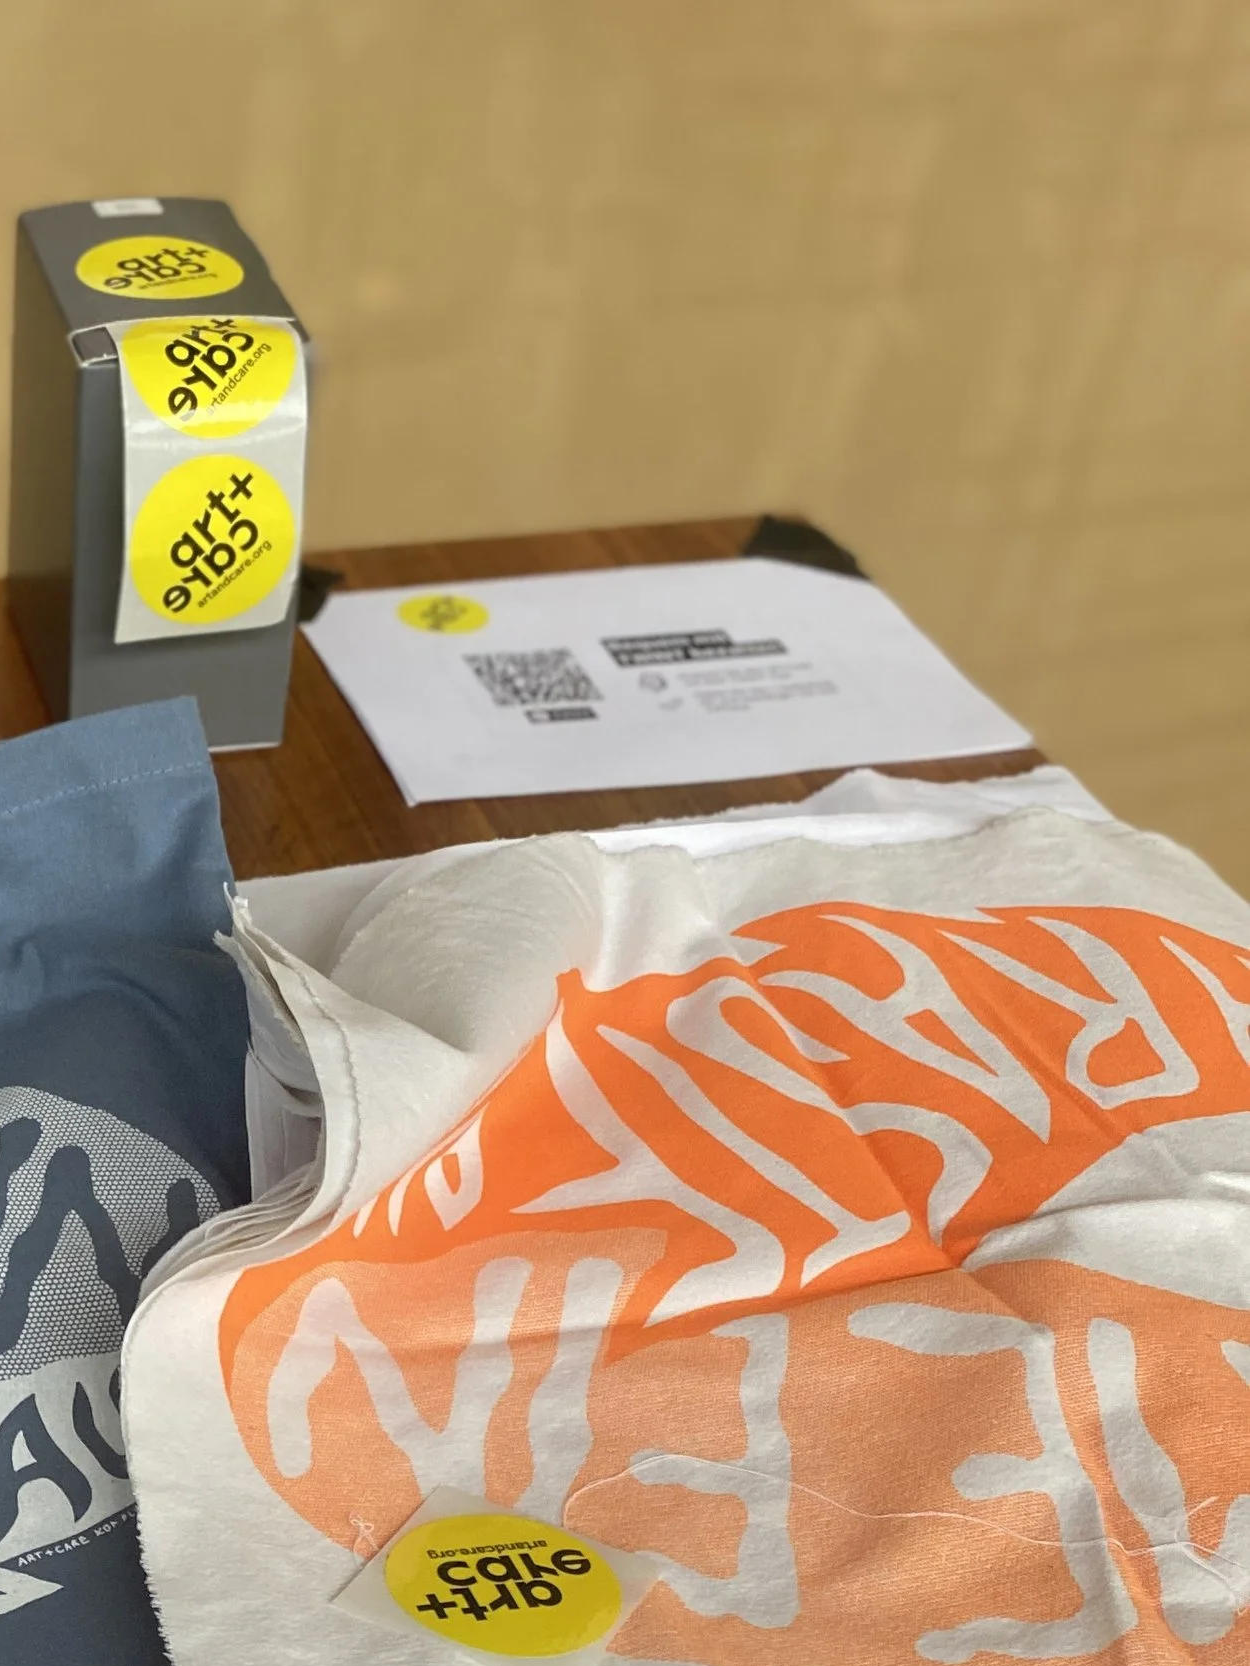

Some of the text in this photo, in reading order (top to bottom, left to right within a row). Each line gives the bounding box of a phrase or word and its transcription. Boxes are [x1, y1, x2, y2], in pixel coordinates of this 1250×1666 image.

[168, 332, 254, 421] care
[170, 472, 254, 568] art+
[163, 519, 258, 613] care
[197, 539, 272, 608] artandcare.org
[427, 1539, 548, 1560] artandcare.org
[437, 1549, 591, 1587] care
[416, 1579, 563, 1621] art+
